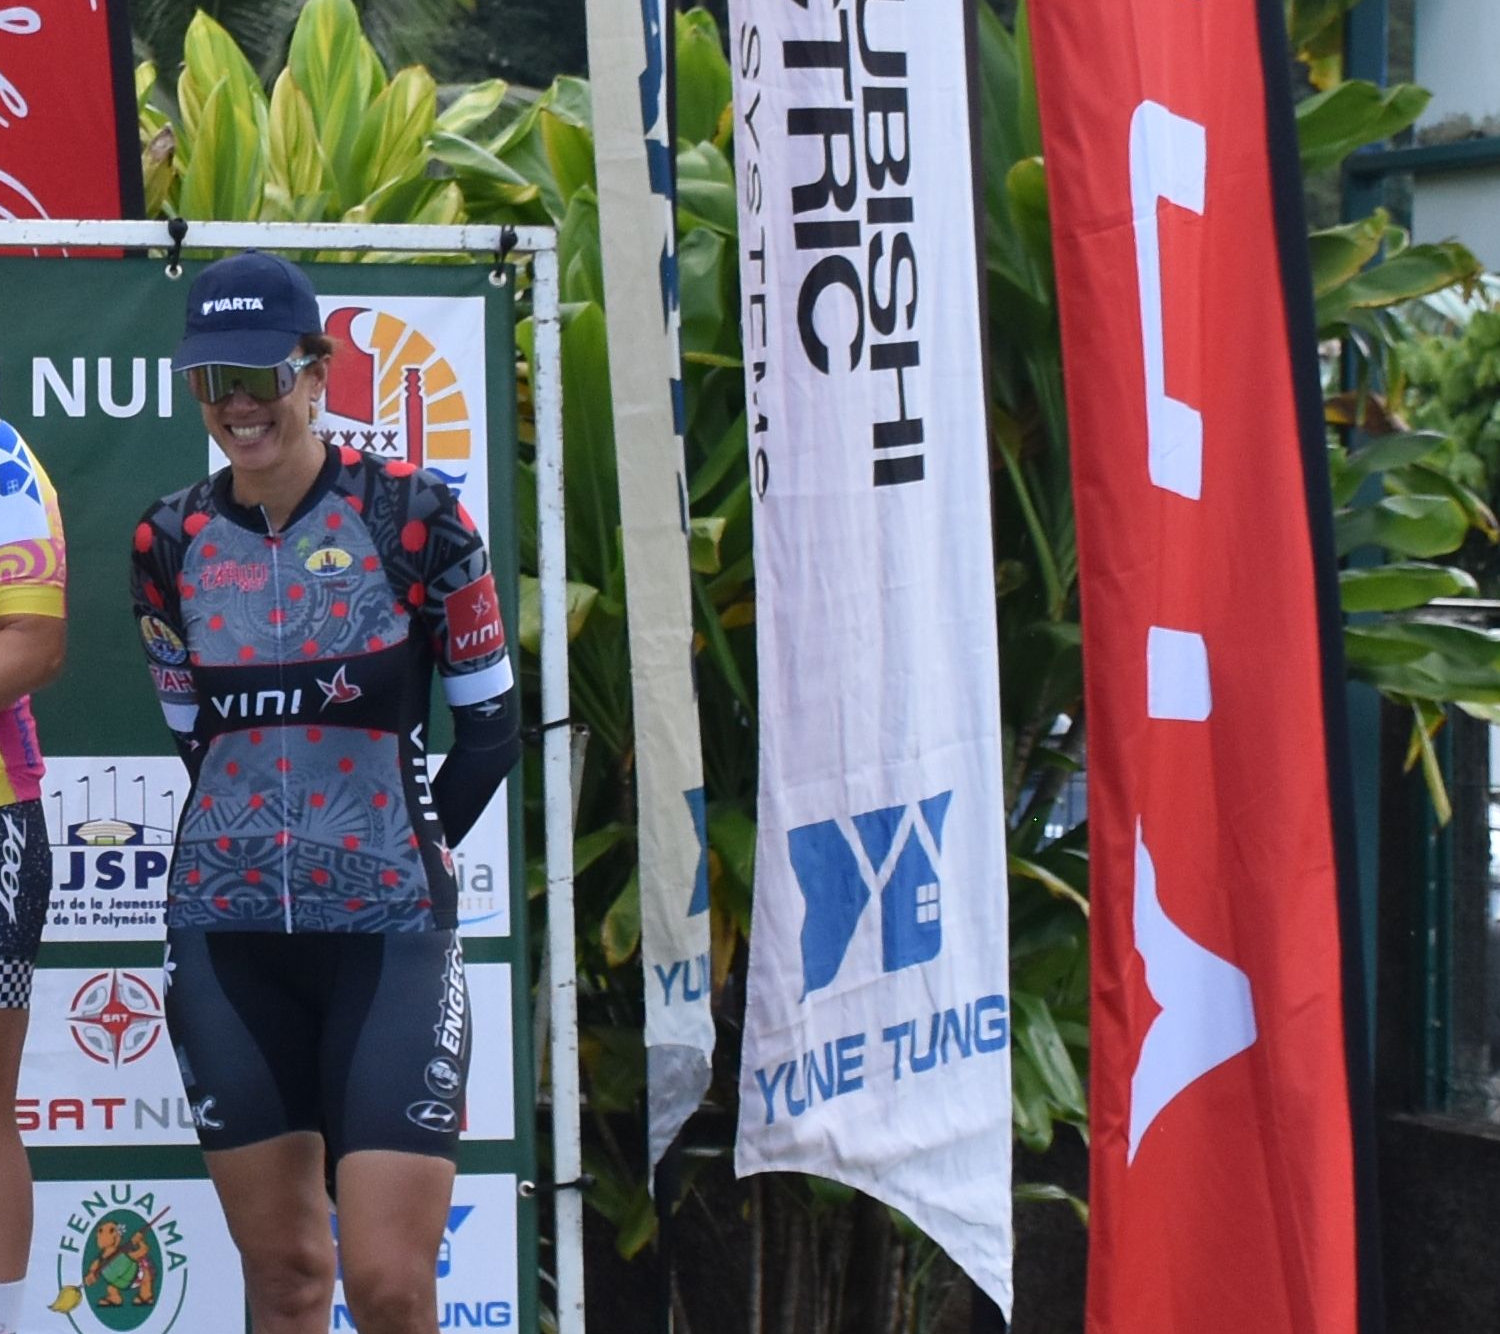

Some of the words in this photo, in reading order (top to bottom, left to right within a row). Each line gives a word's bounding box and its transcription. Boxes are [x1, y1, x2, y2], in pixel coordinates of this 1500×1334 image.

[213, 296, 264, 312] VARTA
[31, 357, 174, 419] NUI
[58, 850, 169, 890] JSP
[69, 897, 86, 910] de
[90, 897, 103, 910] la
[52, 913, 70, 926] de
[74, 913, 87, 926] la
[92, 912, 157, 929] Polynésie
[102, 1013, 129, 1023] SAT
[754, 1032, 865, 1126] YUNE
[882, 994, 1008, 1081] TUNG
[59, 1183, 155, 1254] FENUA
[157, 1220, 188, 1272] MA
